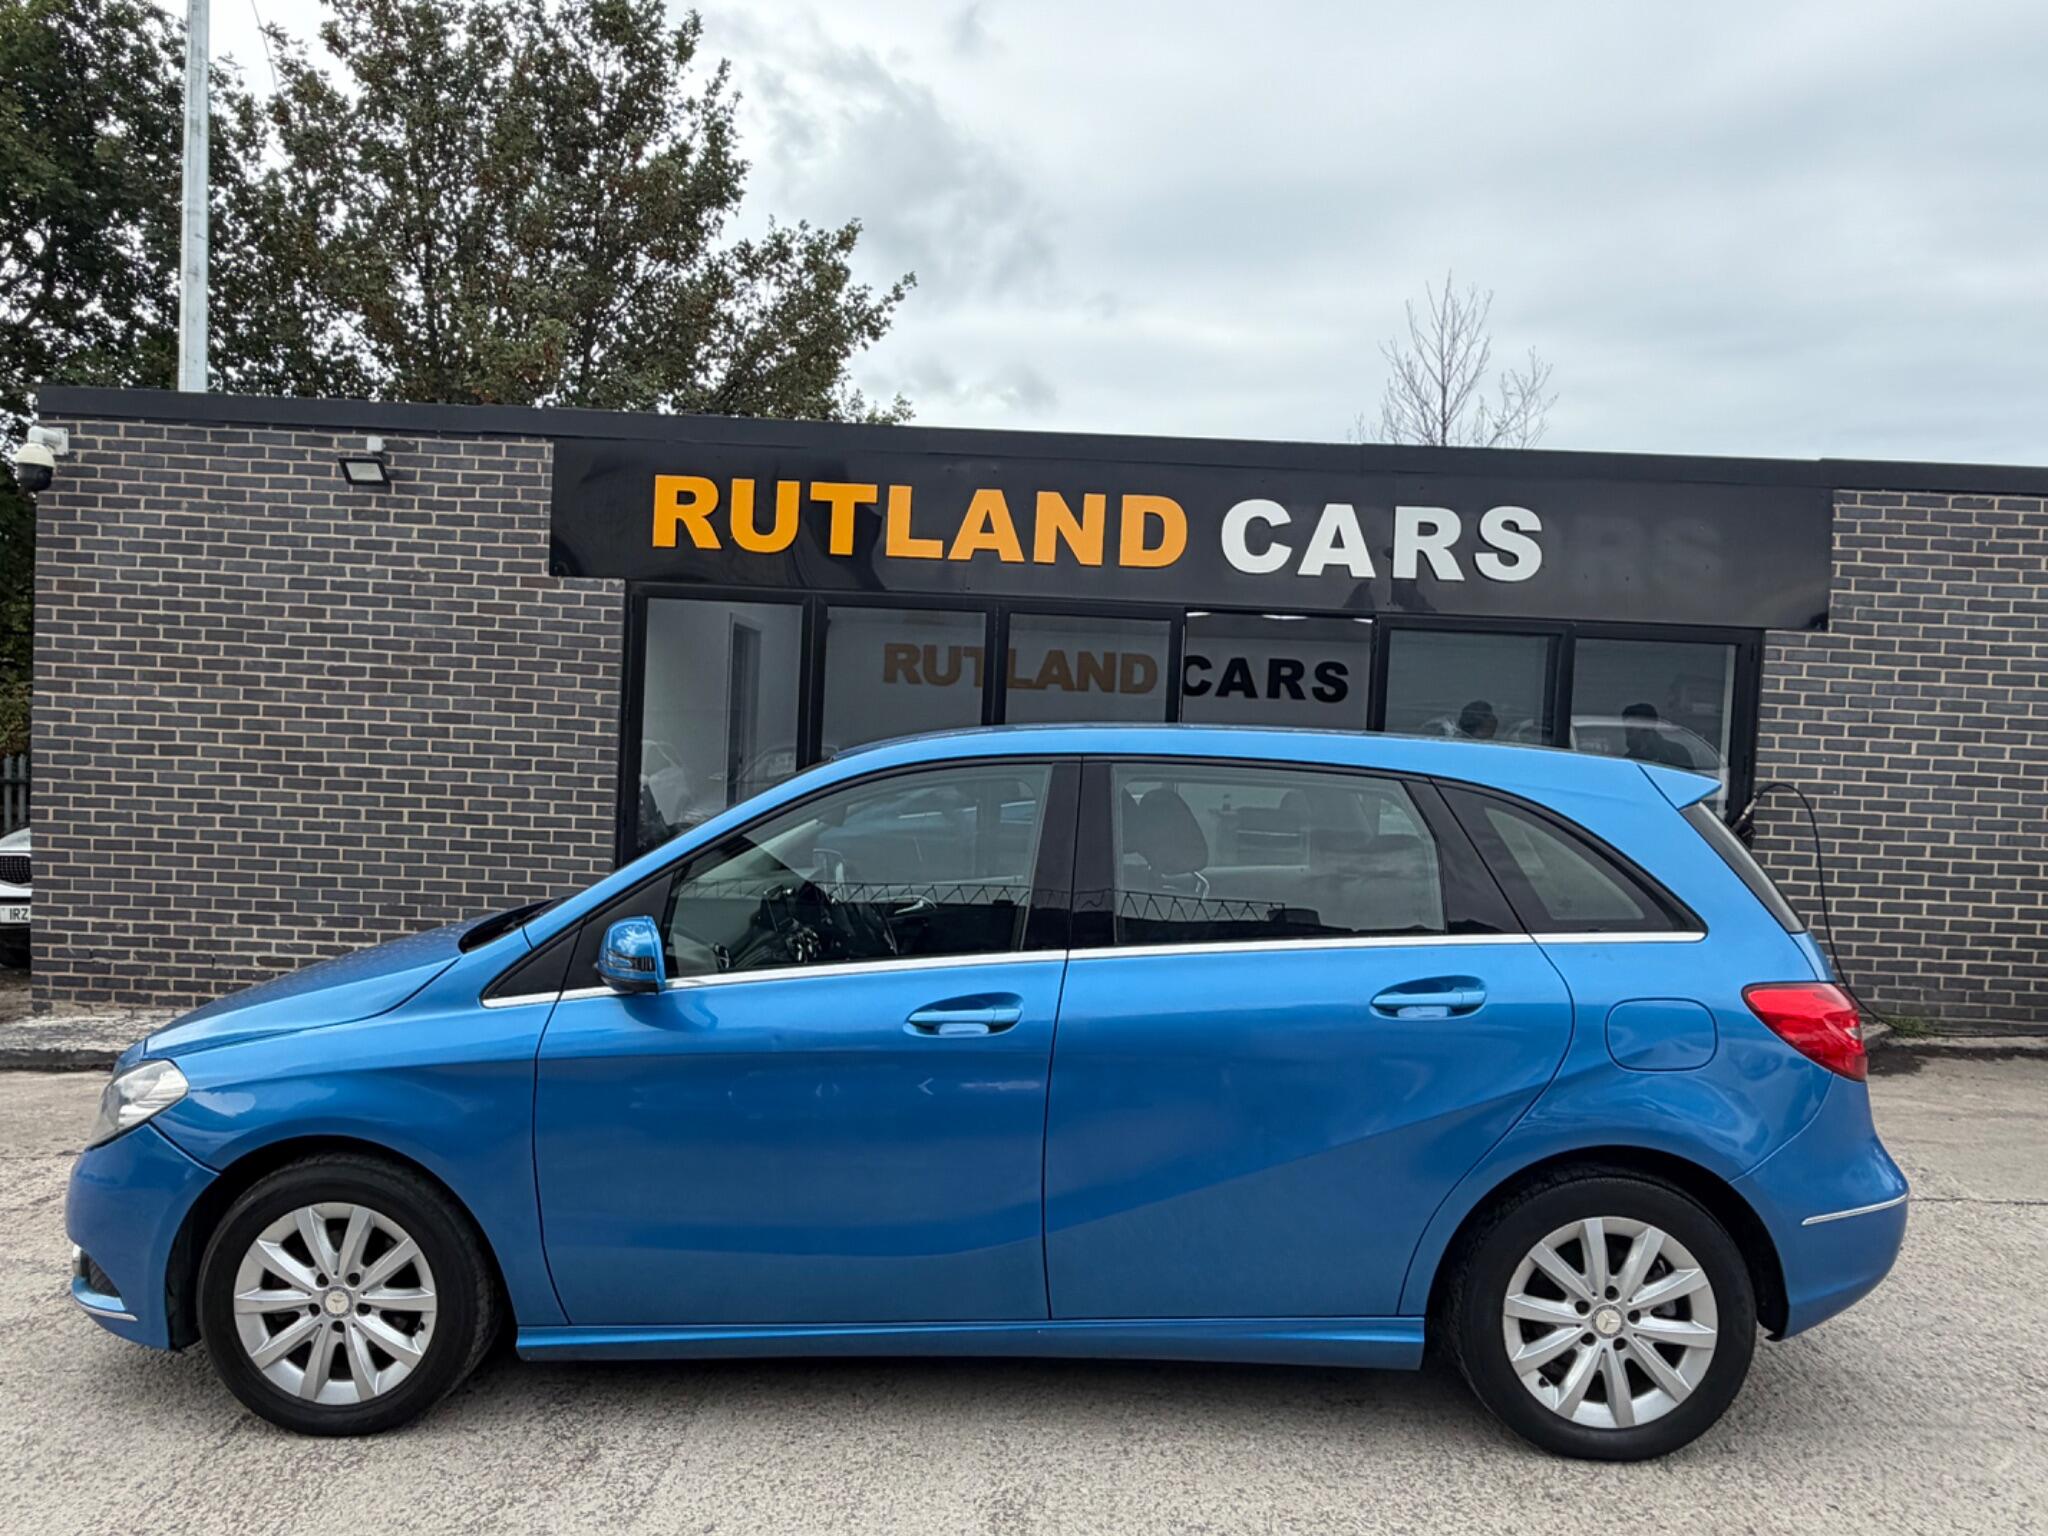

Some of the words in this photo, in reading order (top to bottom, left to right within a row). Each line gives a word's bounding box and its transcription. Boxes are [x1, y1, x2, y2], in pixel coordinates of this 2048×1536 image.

[651, 473, 1187, 569] RUTLAND
[1220, 498, 1544, 583] CARS
[1181, 655, 1349, 704] CARS
